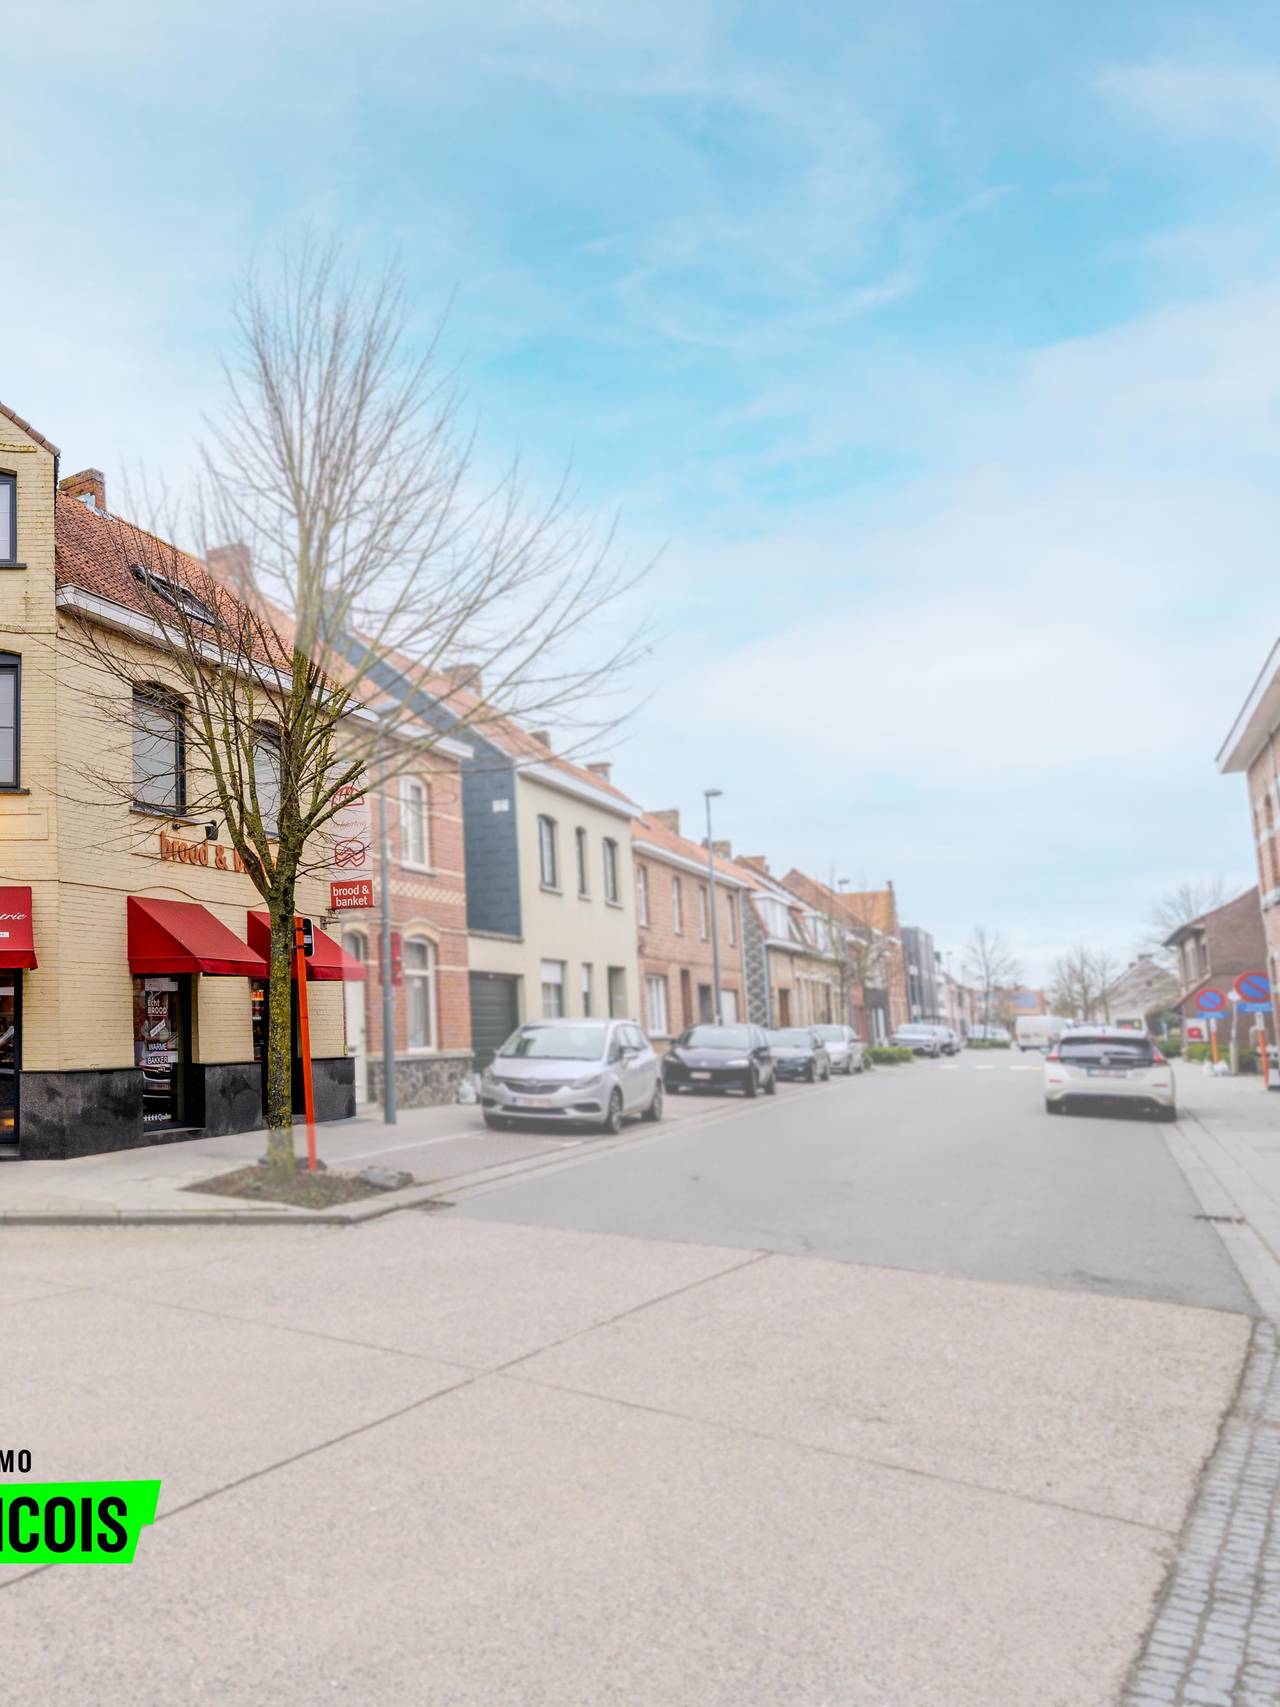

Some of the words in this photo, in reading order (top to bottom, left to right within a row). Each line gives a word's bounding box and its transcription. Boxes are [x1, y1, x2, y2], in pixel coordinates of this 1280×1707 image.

[160, 831, 209, 866] brood
[215, 844, 228, 870] &
[333, 885, 359, 896] brood
[362, 885, 370, 894] &
[336, 895, 368, 907] banket
[147, 1006, 168, 1014] BROOD
